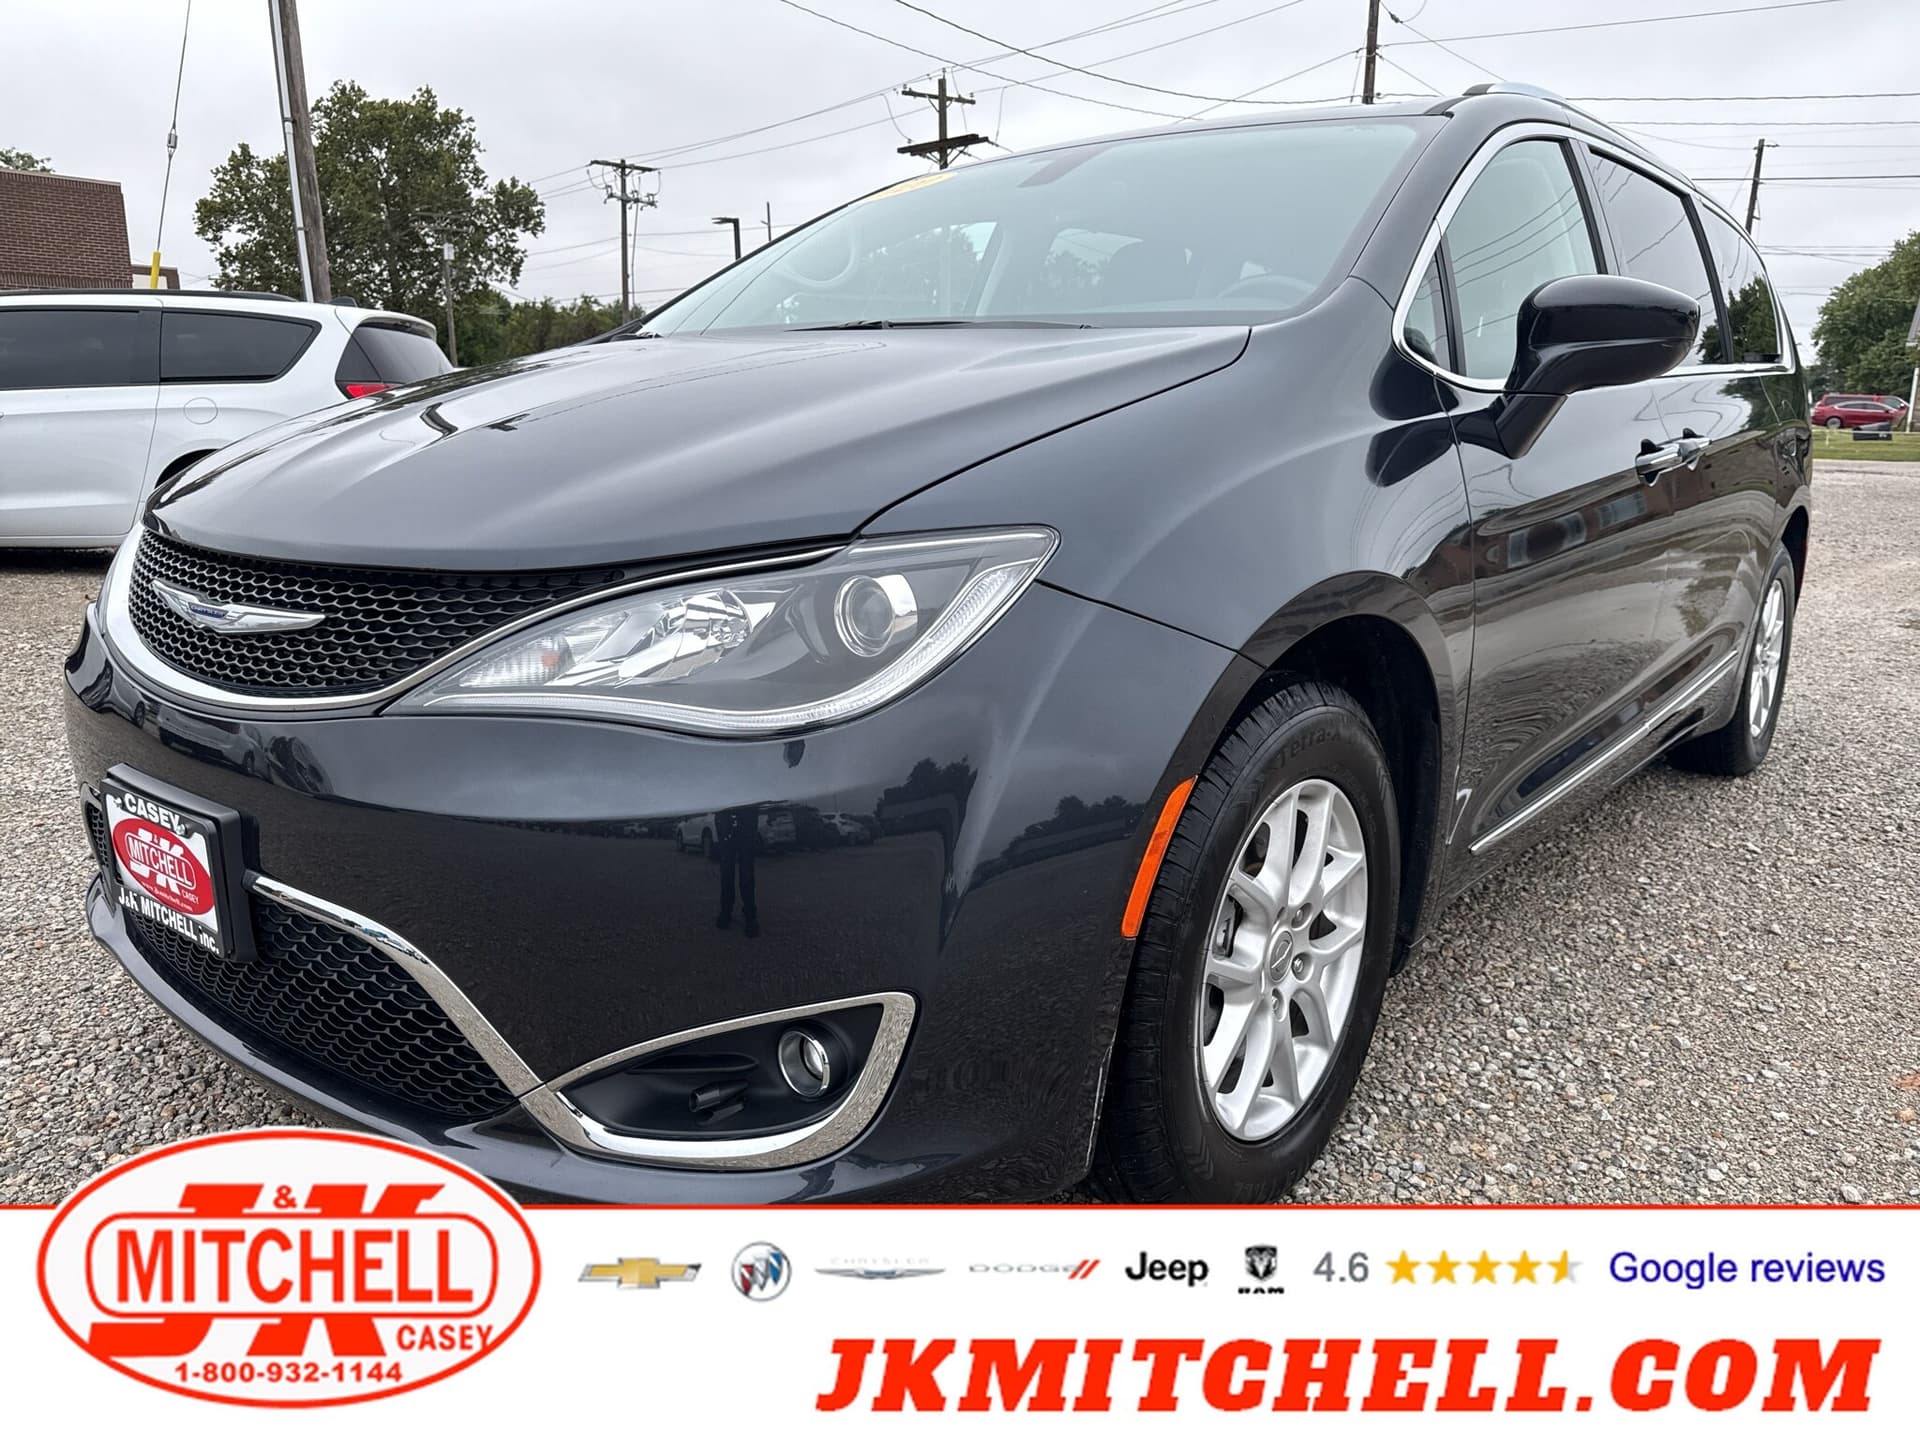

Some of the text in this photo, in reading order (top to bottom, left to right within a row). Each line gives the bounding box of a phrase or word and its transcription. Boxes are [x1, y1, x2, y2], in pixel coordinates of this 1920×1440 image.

[124, 793, 180, 832] CASEY
[127, 836, 193, 886] MITCHELL
[141, 896, 198, 941] MITCHELL
